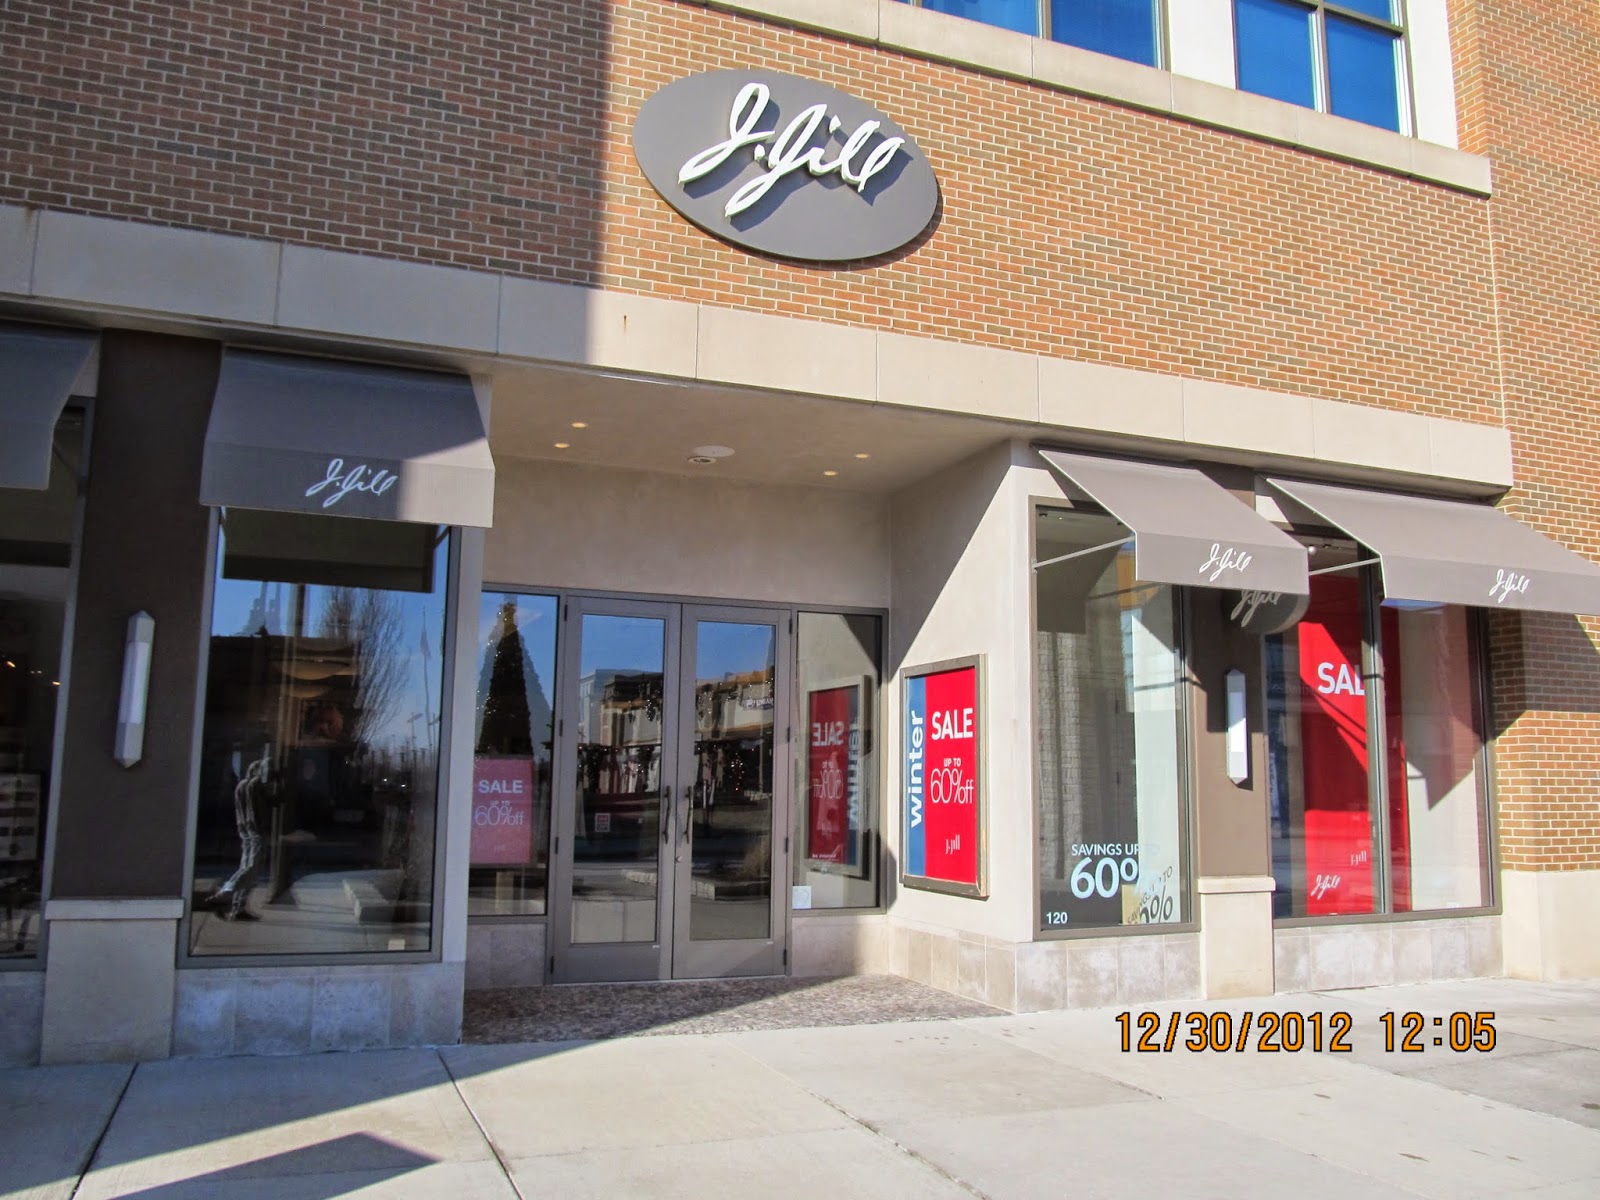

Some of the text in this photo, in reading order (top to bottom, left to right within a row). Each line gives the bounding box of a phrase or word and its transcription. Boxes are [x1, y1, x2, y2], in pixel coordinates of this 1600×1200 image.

[1317, 661, 1368, 696] SAL
[931, 707, 974, 740] SALE
[908, 710, 924, 828] winter
[943, 758, 962, 767] UP TO
[478, 779, 523, 794] SALE
[1071, 843, 1122, 856] SAVINGS
[1046, 912, 1068, 925] 120
